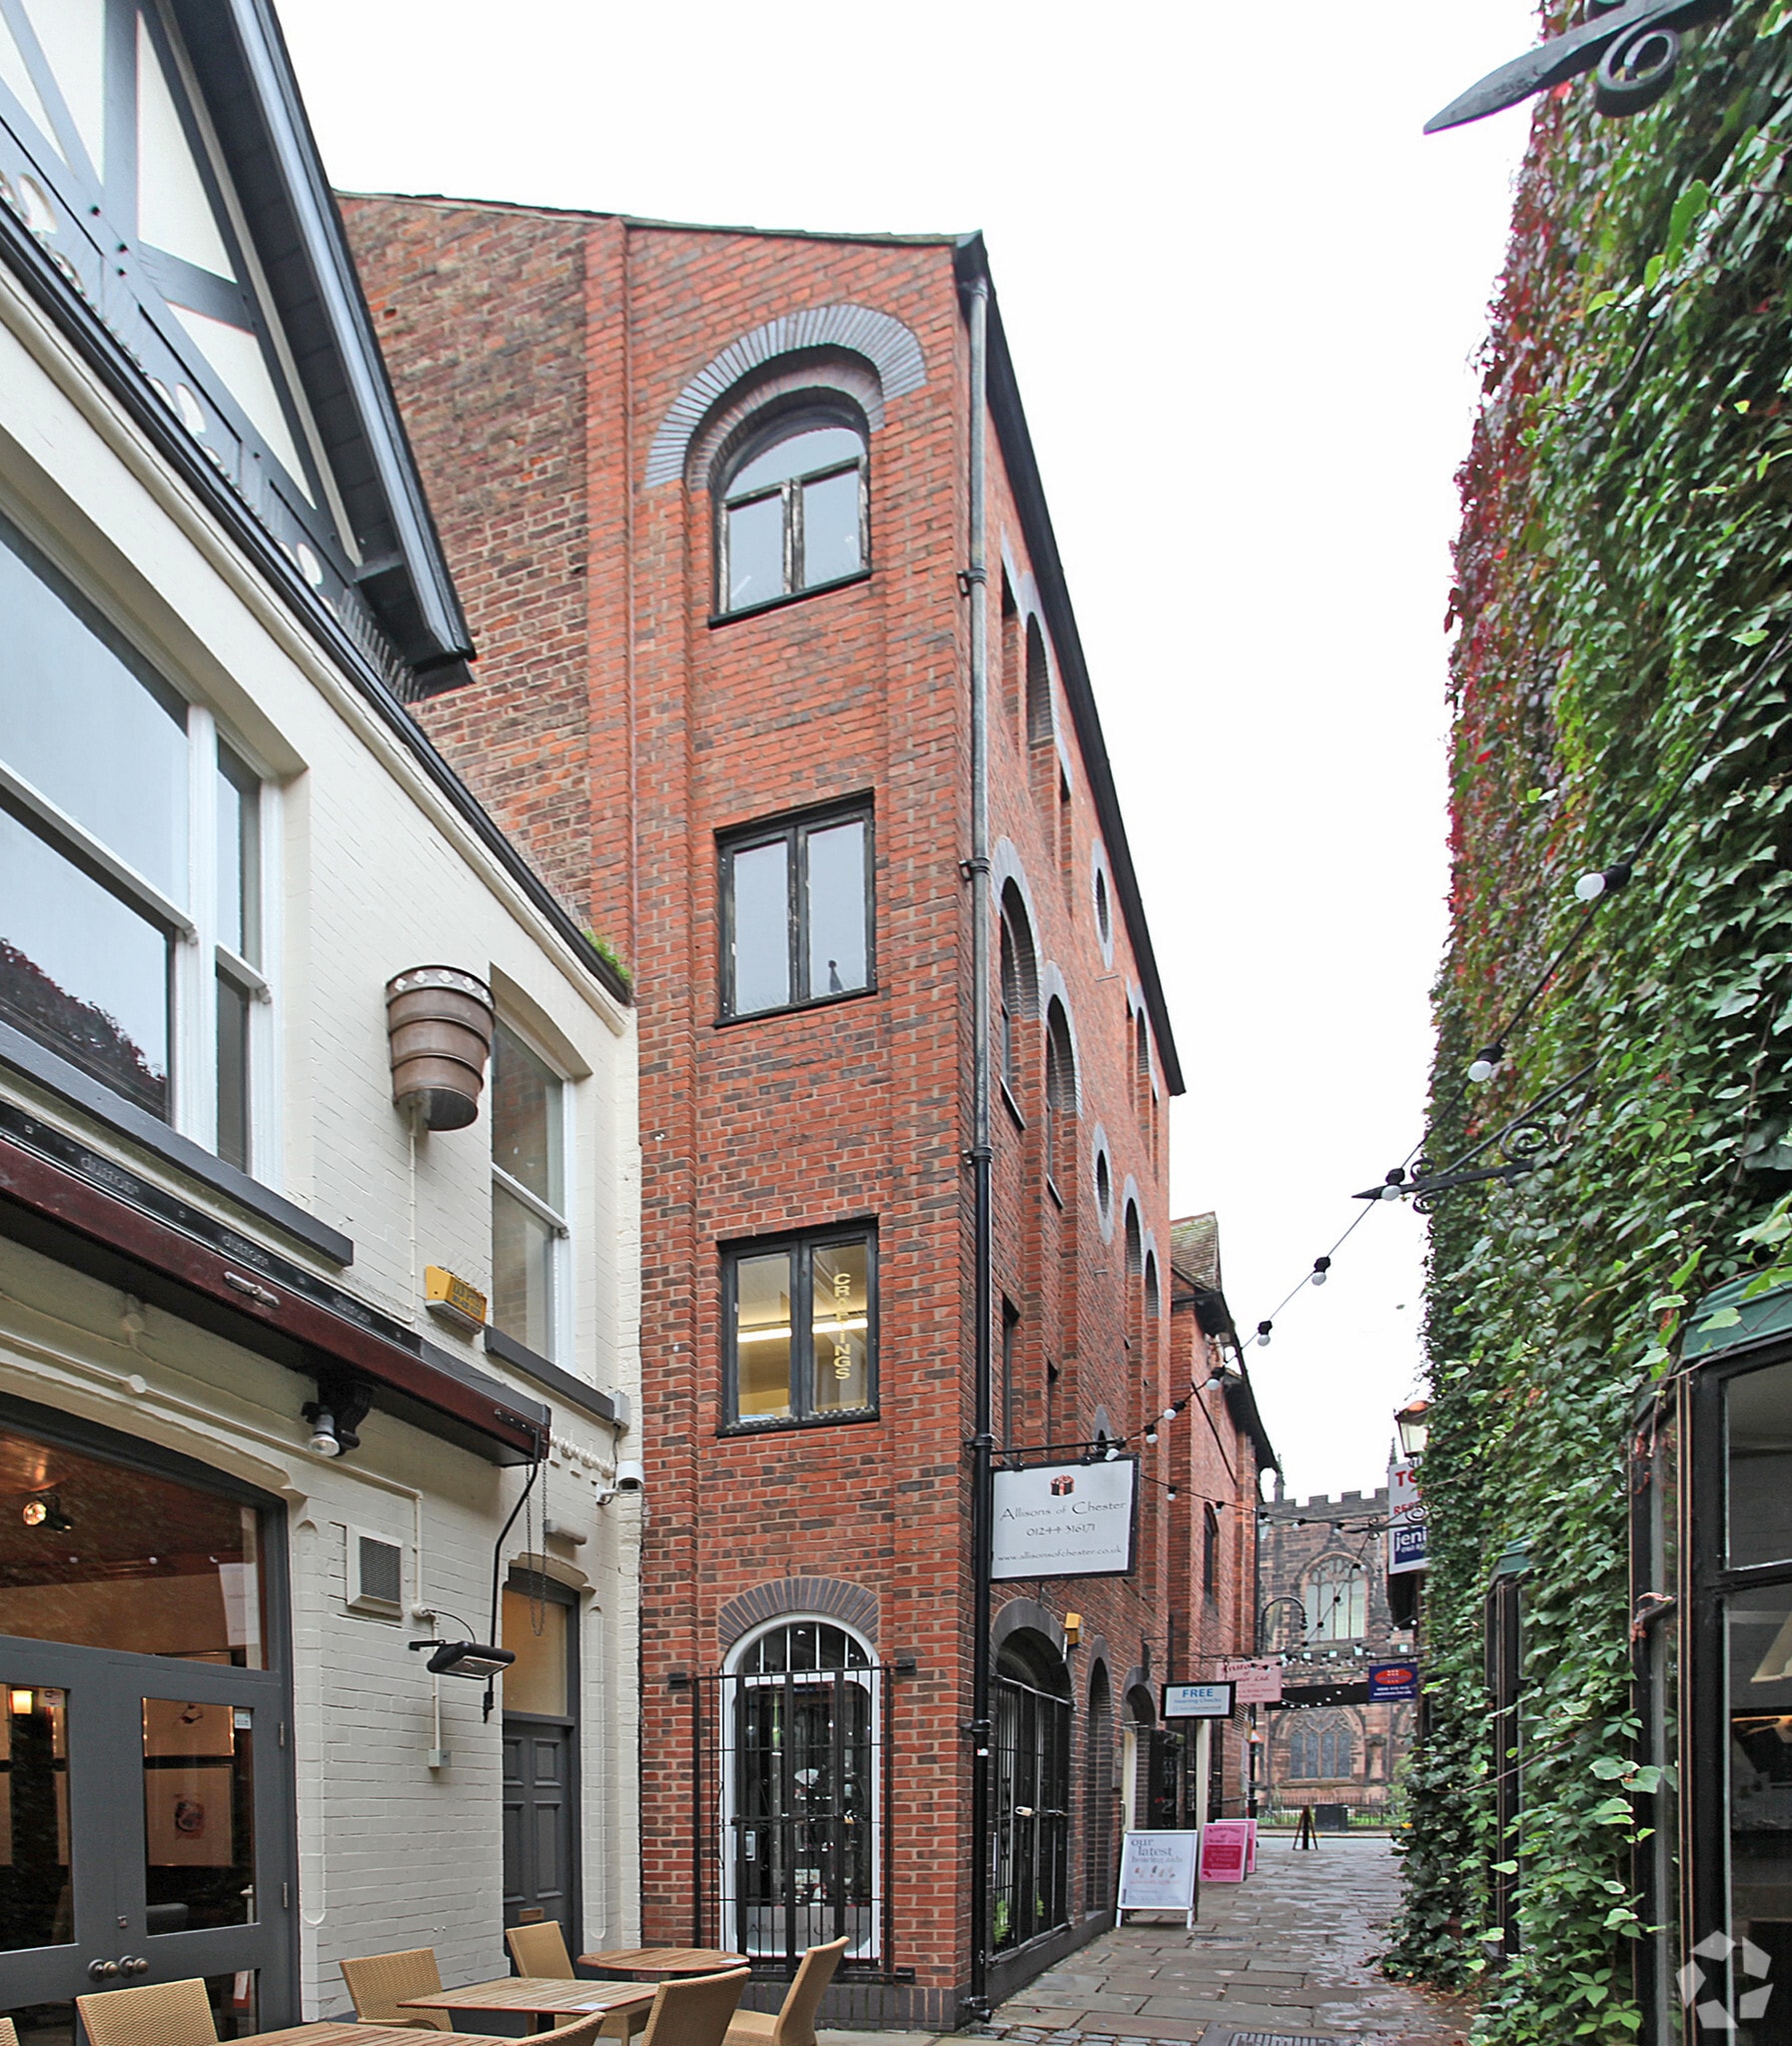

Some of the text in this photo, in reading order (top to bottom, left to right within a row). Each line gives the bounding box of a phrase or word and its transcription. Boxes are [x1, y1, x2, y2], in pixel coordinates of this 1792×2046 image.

[999, 1501, 1127, 1523] Allisons of Chester
[1026, 1526, 1062, 1537] 01244
[1182, 1687, 1215, 1698] FREE
[1131, 1838, 1155, 1847] our
[1138, 1845, 1173, 1856] latest
